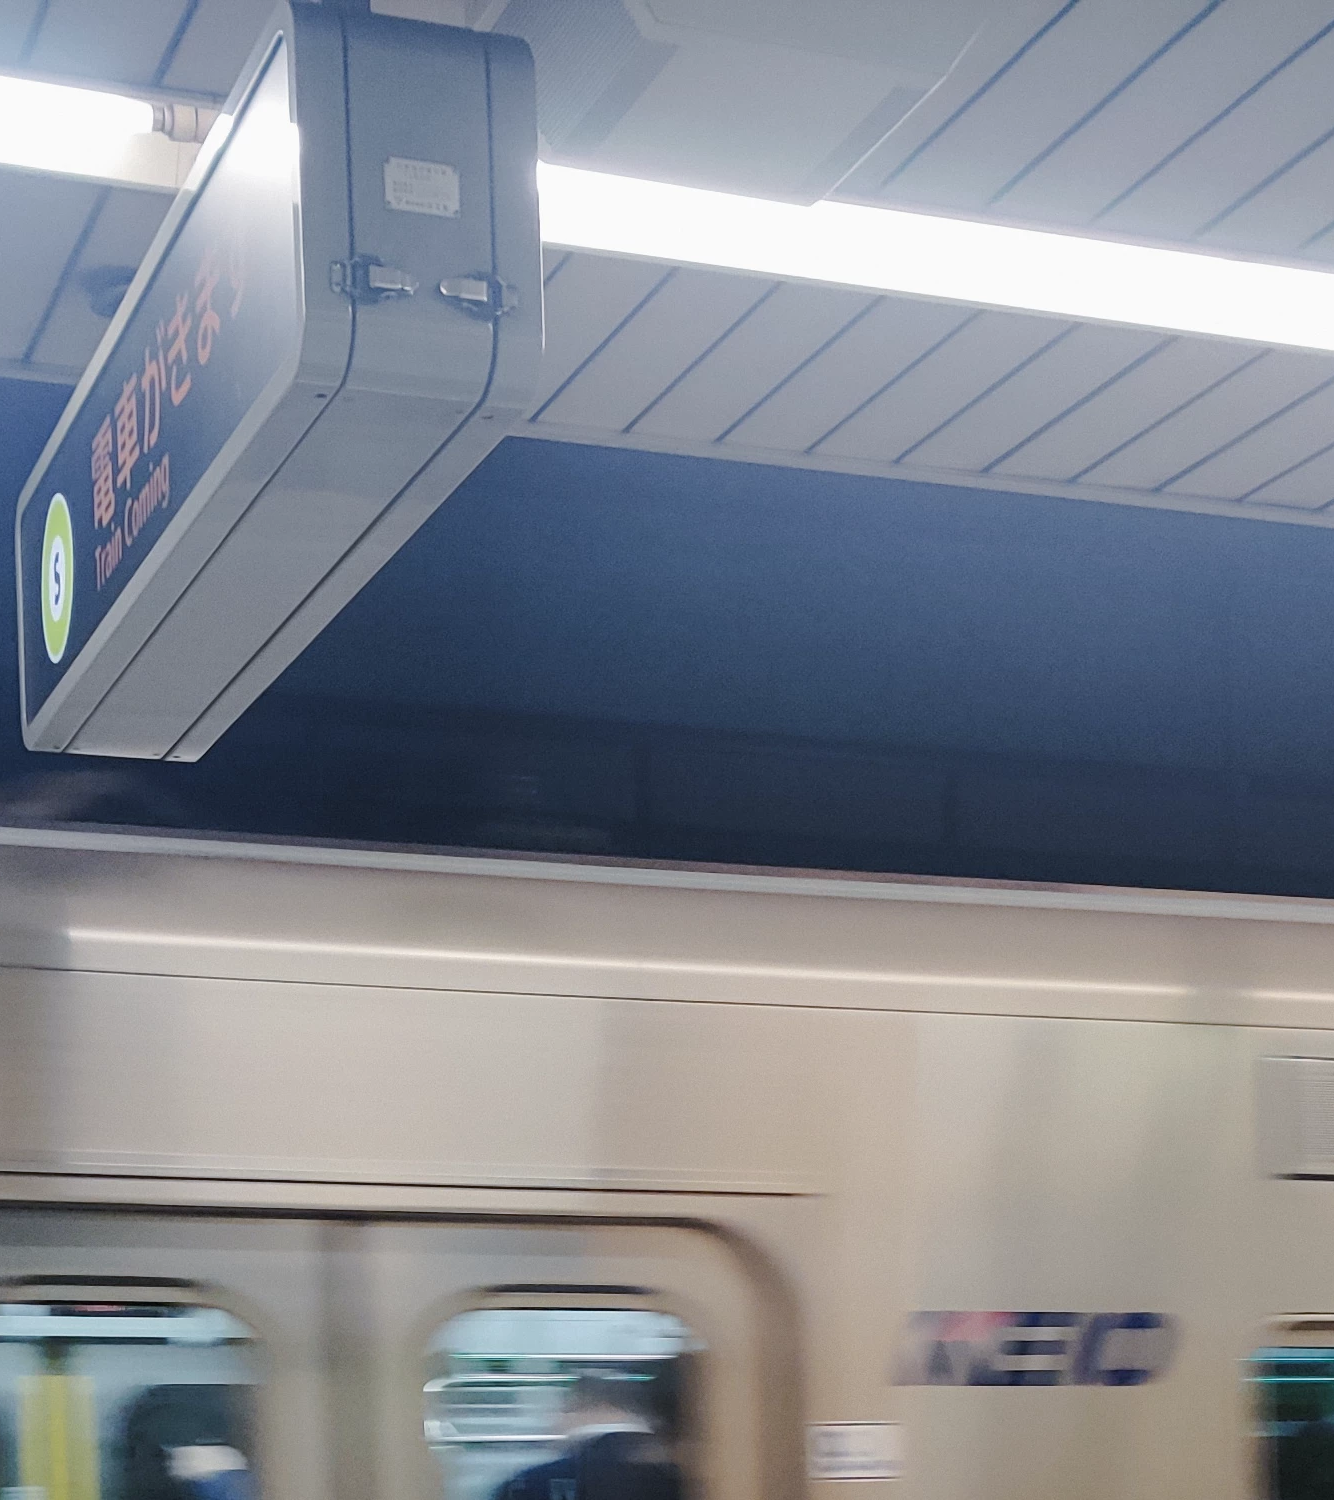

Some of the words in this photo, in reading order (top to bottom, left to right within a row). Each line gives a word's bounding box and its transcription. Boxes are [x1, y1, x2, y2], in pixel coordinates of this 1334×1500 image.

[95, 521, 122, 592] Train
[125, 452, 170, 547] Coming
[53, 551, 61, 606] S
